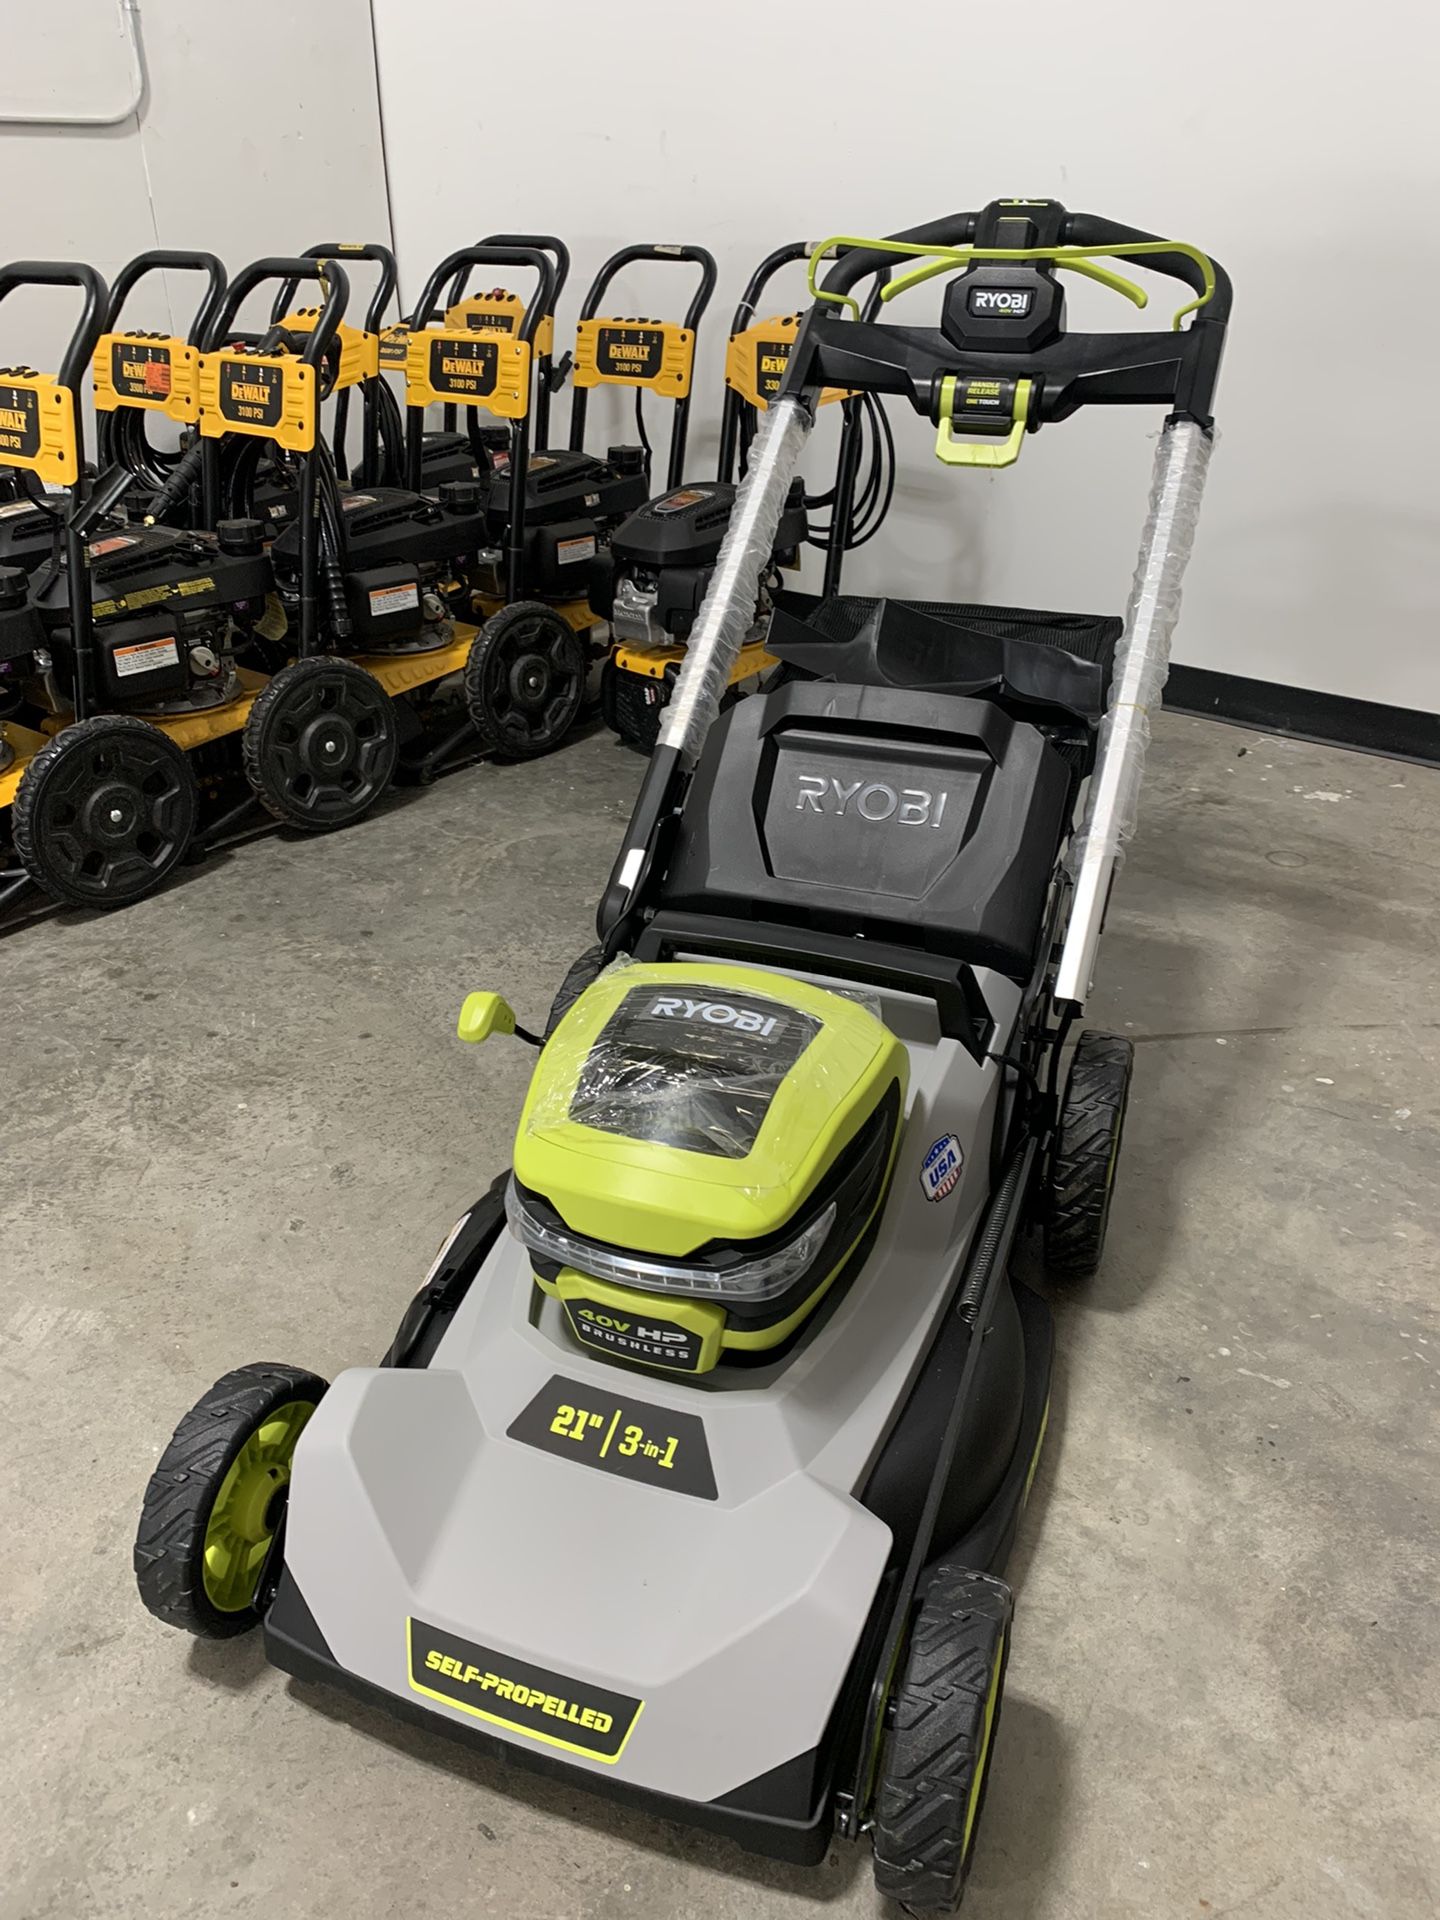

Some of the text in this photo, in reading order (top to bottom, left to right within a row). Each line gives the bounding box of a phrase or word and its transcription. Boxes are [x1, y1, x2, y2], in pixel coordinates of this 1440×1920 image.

[976, 292, 1028, 309] RYOBI
[610, 345, 650, 361] DEWALT
[443, 358, 484, 376] DEWALT
[616, 363, 642, 373] 3100 PSI
[762, 357, 788, 374] DEW
[449, 378, 477, 390] 3100 PSI
[764, 379, 781, 391] 330
[967, 388, 1000, 396] RELEASE
[232, 383, 270, 404] DEWALT
[0, 410, 26, 431] WALT
[254, 407, 264, 419] PSI
[10, 435, 22, 449] PSI
[795, 775, 948, 829] RYOBI
[650, 997, 778, 1037] RYOBI
[928, 1149, 957, 1188] USA
[577, 1309, 688, 1352] 40V HP
[581, 1323, 690, 1359] BRUSHLESS
[549, 1404, 679, 1469] 21" 3-in-1
[424, 1649, 613, 1734] SELF-PROPELLED
